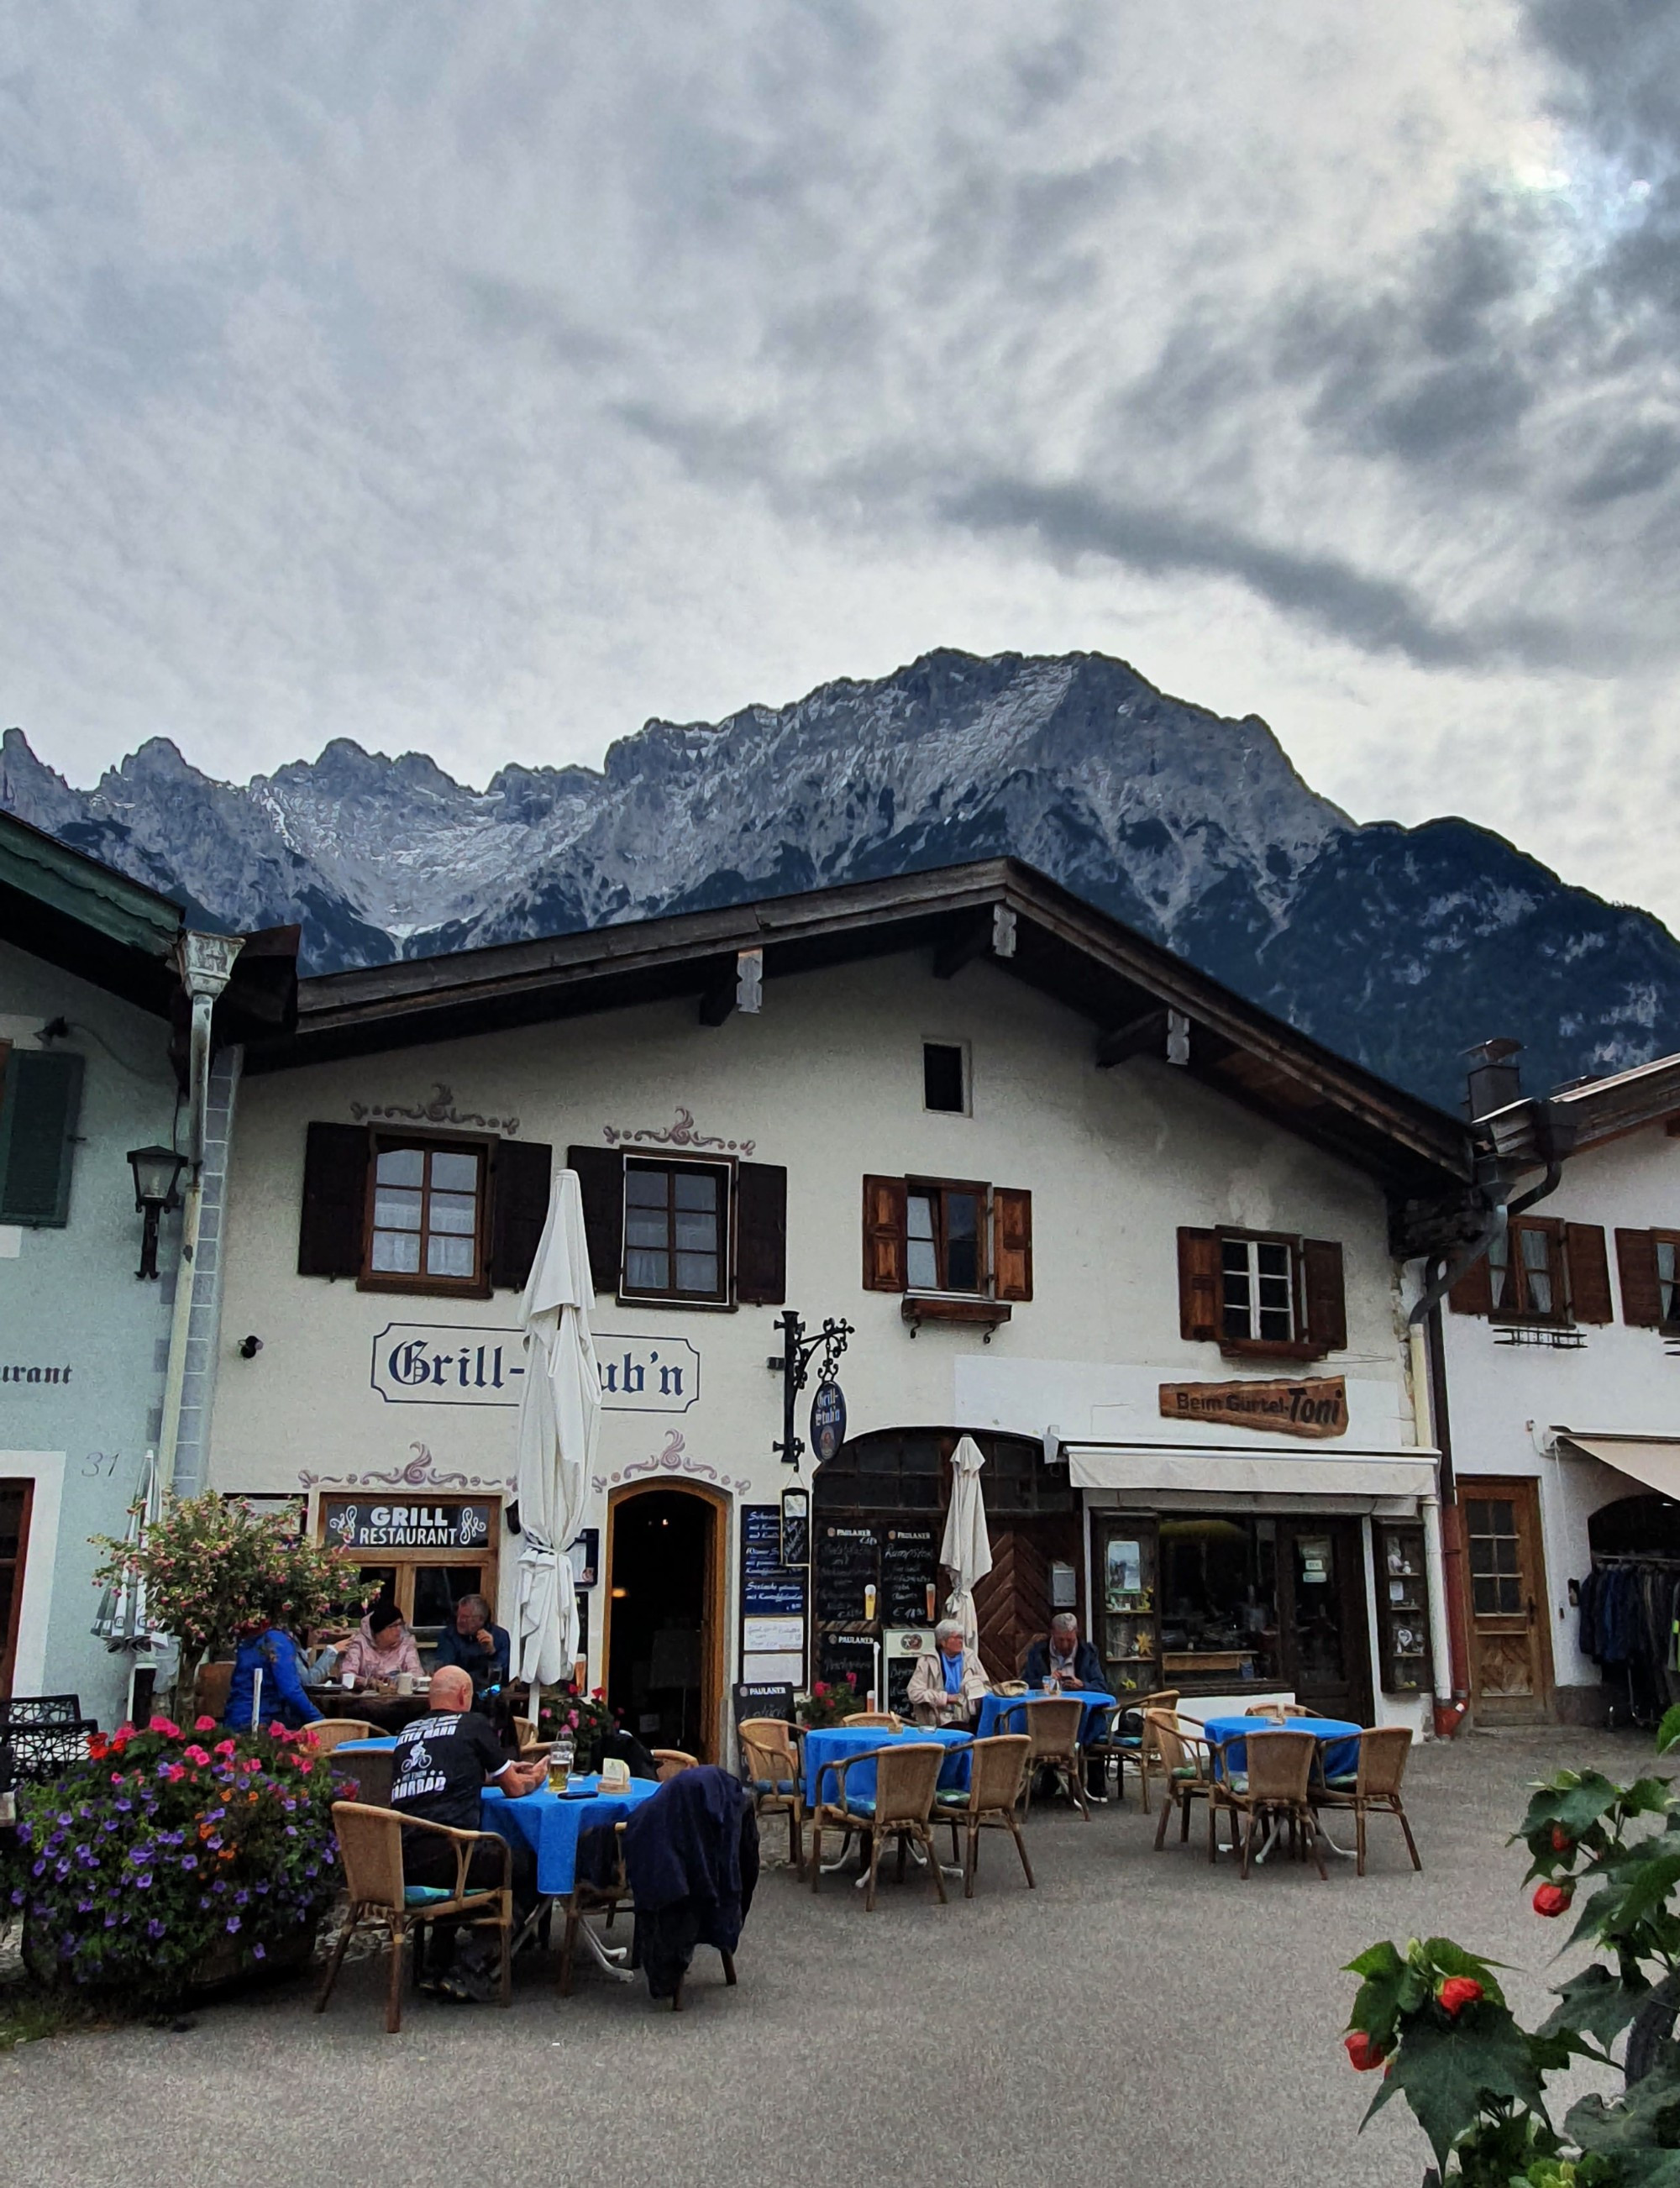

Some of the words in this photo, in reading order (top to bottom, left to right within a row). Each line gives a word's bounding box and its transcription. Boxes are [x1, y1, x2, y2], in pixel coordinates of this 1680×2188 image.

[388, 1340, 525, 1388] Grill-
[596, 1351, 684, 1395] ub'n
[1177, 1392, 1221, 1411] Beim
[81, 1451, 120, 1477] 31
[370, 1506, 449, 1527] GRILL
[359, 1527, 458, 1545] RESTAURANT
[749, 1687, 786, 1695] PAULANER
